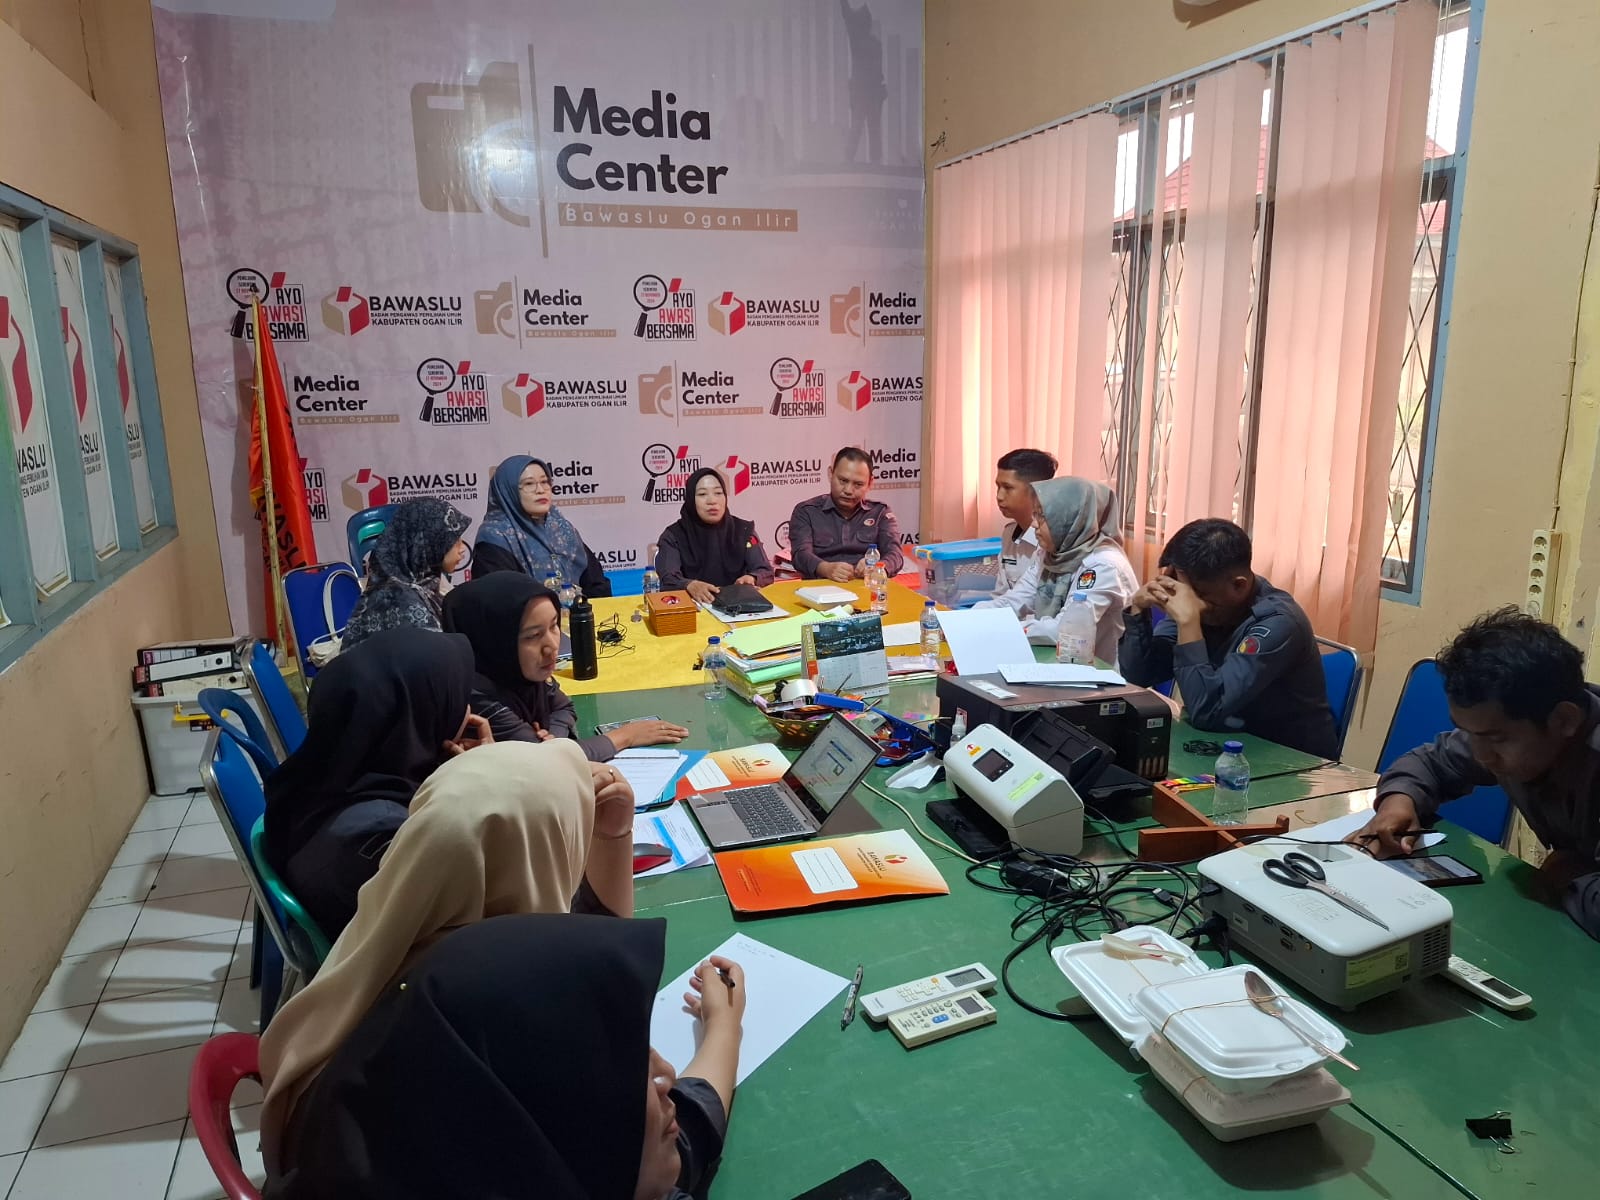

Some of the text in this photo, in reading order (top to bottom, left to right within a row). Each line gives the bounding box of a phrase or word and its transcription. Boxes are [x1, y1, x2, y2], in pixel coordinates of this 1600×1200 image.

[553, 85, 711, 140] Media
[556, 142, 729, 194] Center
[566, 206, 792, 228] Bawaslu Ogan Ilir
[276, 288, 301, 304] AYO
[369, 296, 461, 311] BAWASLU
[523, 288, 582, 306] Media
[672, 292, 693, 308] AYO
[869, 291, 916, 308] Media
[746, 300, 820, 313] BAWASLU
[525, 308, 589, 325] Center
[659, 308, 693, 323] AWASI
[869, 310, 922, 325] Center
[246, 322, 306, 340] BSAMA
[647, 323, 694, 339] BERSAMA
[294, 375, 360, 392] Media
[461, 374, 485, 391] AYO
[544, 380, 627, 394] BAWASLU
[682, 371, 734, 387] Media
[805, 373, 823, 387] AYO
[446, 391, 486, 407] AWASI
[682, 389, 740, 405] Center
[793, 387, 824, 402] AWASI
[295, 395, 368, 412] Center
[781, 402, 824, 416] BERSAMA
[433, 407, 488, 423] BERSAMA
[870, 448, 916, 463] Media
[680, 458, 699, 473] AYO
[750, 460, 821, 474] BAWASLU
[302, 472, 323, 489] YO
[388, 473, 477, 490] BAWASLU
[551, 481, 599, 495] enter
[751, 479, 789, 487] KABUPATEN
[654, 487, 686, 503] BERSA
[598, 550, 637, 564] ASLU
